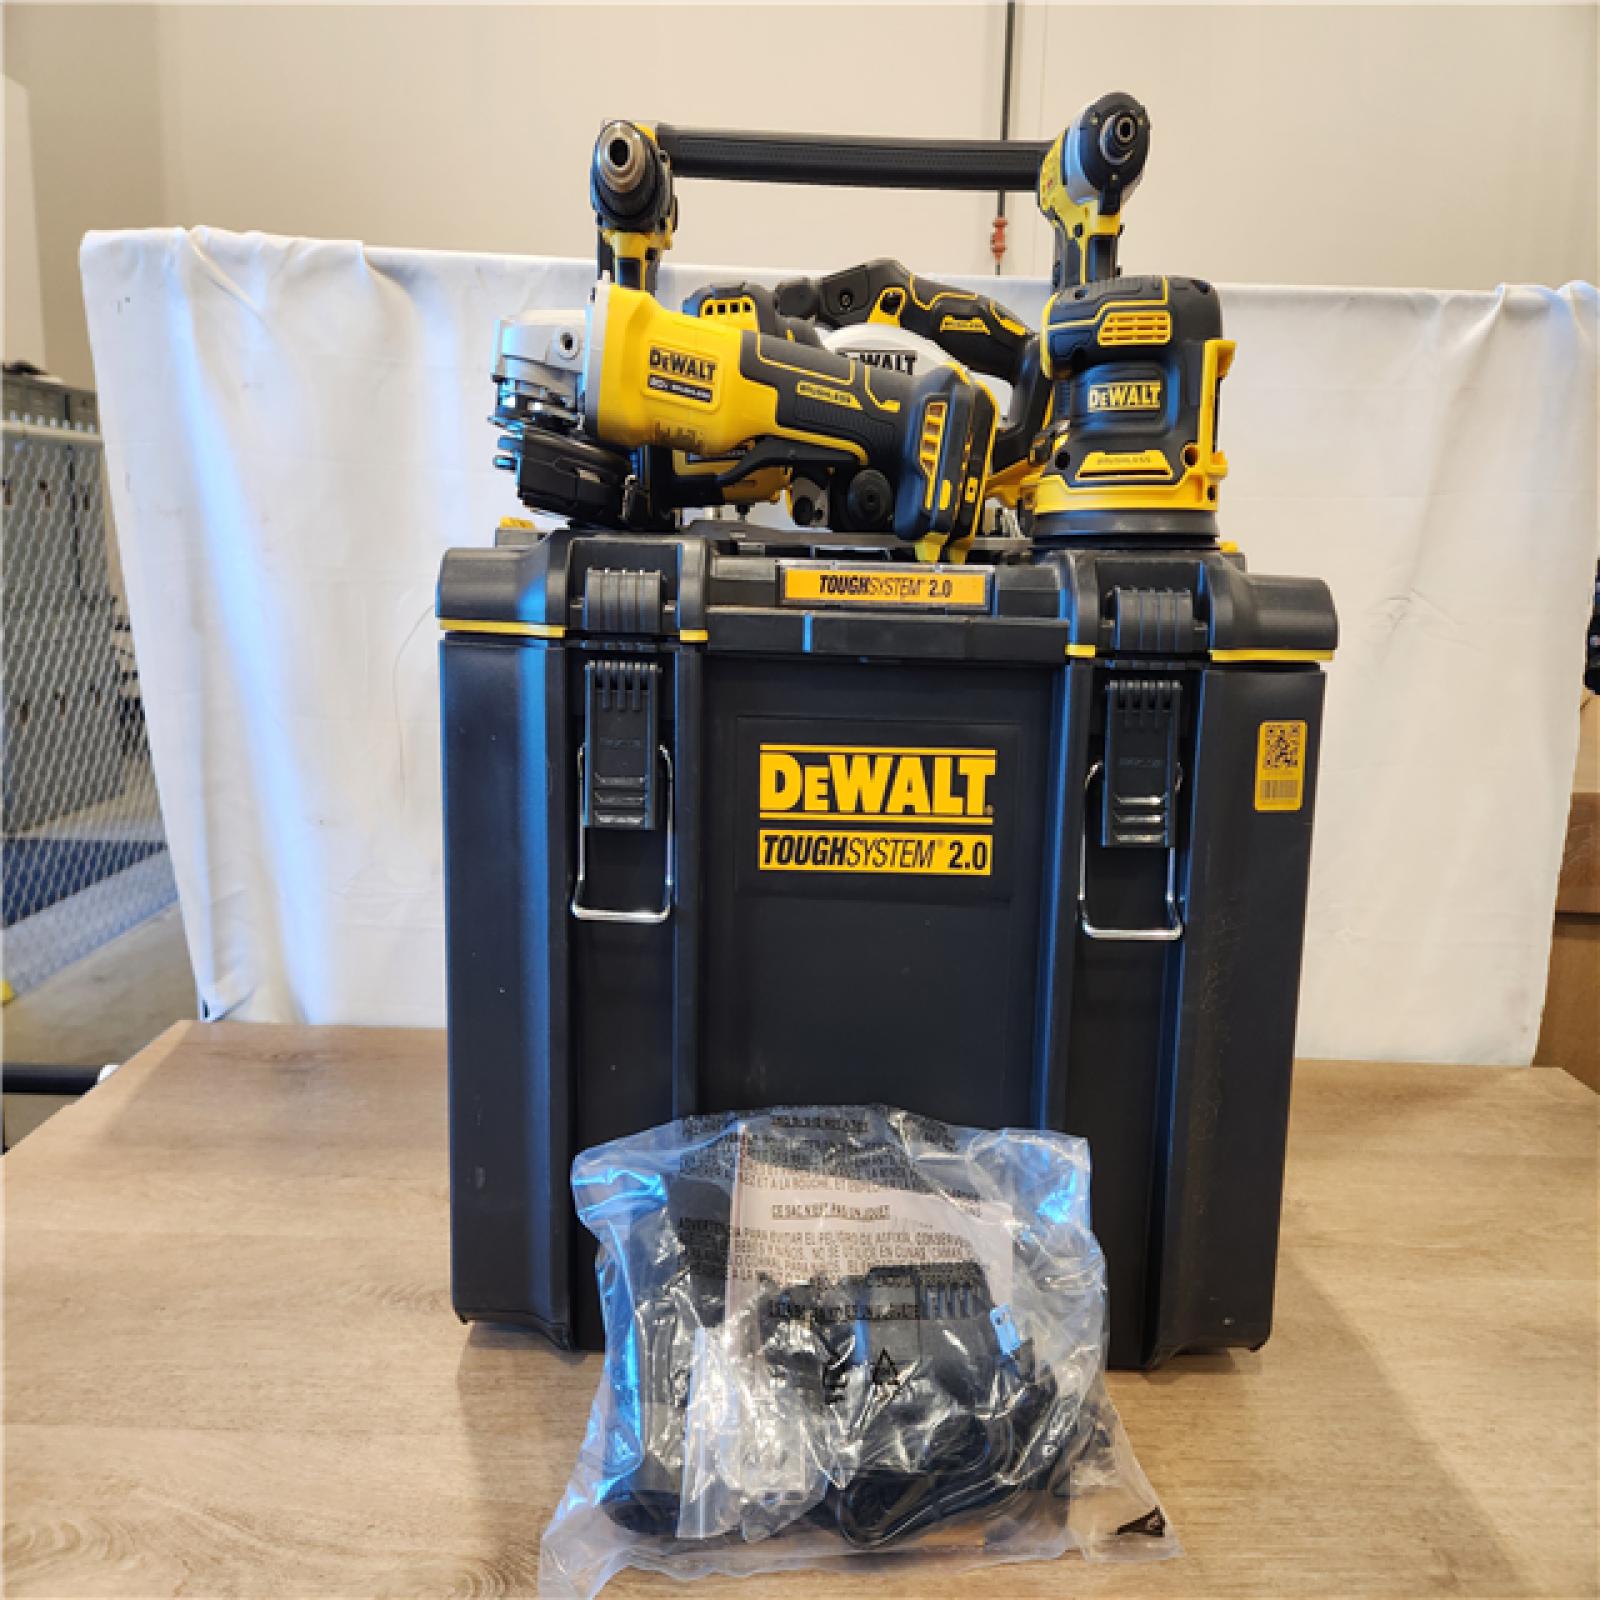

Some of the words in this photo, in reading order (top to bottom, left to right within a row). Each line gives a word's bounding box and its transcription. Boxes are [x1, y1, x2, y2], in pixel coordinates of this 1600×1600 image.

[819, 574, 921, 597] TOUGHSYSTEM
[928, 579, 953, 598] 2.0
[764, 834, 936, 869] TOUGHSYSTEM
[948, 840, 988, 871] 2.0
